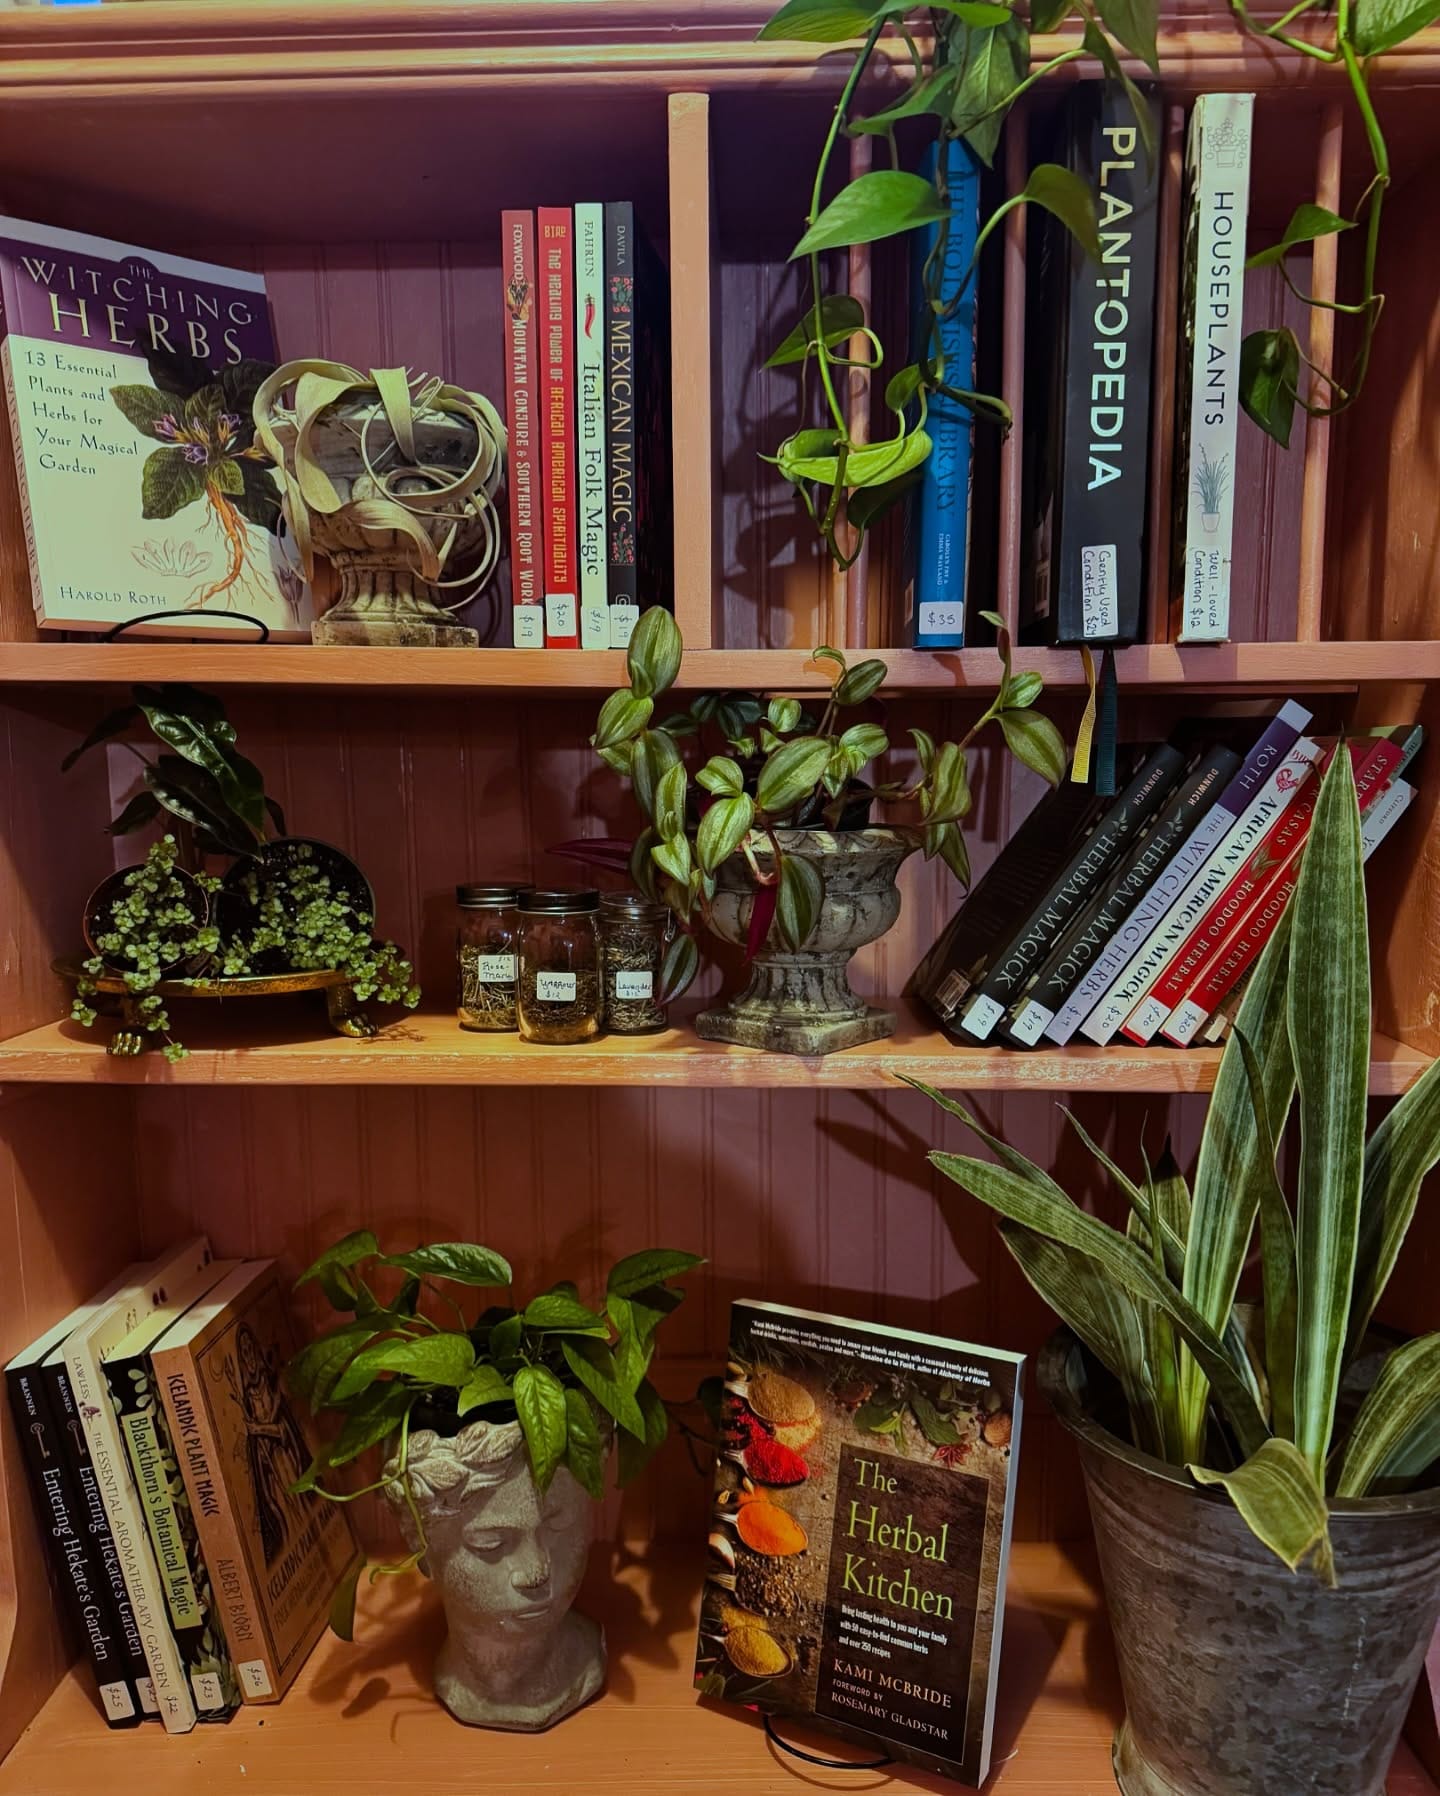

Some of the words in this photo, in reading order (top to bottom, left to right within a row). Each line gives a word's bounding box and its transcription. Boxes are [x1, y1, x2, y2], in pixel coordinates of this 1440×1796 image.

[129, 263, 151, 280] THE
[513, 224, 524, 280] FOXWOOD
[584, 221, 594, 277] FAHRUN
[617, 225, 626, 266] DAVILA
[20, 256, 252, 325] WITCHING
[1087, 127, 1137, 491] PLANTOPEDIA
[1204, 192, 1234, 425] HOUSEPLANTS
[49, 292, 242, 365] HERBS
[513, 319, 528, 384] MOUNTAIN
[25, 350, 46, 367] 13
[55, 354, 117, 379] Essential
[28, 376, 73, 397] Plants
[81, 387, 105, 401] and
[611, 320, 631, 433] MEXICAN
[33, 401, 76, 422] Herbs
[84, 409, 103, 425] for
[514, 390, 529, 446] CONJURE
[583, 363, 600, 439] Italian
[35, 427, 71, 447] Your
[80, 433, 138, 456] Magical
[39, 454, 96, 475] Garden
[516, 461, 531, 527] SOUTHERN
[585, 448, 602, 498] Folk
[612, 443, 632, 522] MAGIC
[516, 532, 532, 564] ROOT
[582, 507, 603, 575] Magic
[60, 586, 122, 602] HAROLD
[128, 591, 167, 606] ROTH
[519, 570, 534, 606] WORK
[1083, 550, 1095, 612] Condition
[1193, 551, 1206, 604] Condition
[552, 604, 569, 626] $20
[927, 611, 956, 628] $35
[1099, 597, 1111, 626] Used
[1133, 768, 1164, 806] DUNWICH
[1189, 768, 1219, 806] DUNWICH
[1240, 744, 1278, 790] ROTH
[1206, 813, 1225, 834] THE
[1224, 796, 1278, 865] AFRICAN
[1275, 801, 1312, 847] CASAS
[1054, 834, 1116, 907] HERBAL
[1108, 835, 1172, 909] HERBAL
[1124, 839, 1209, 943] WITCHING
[1161, 863, 1226, 951] AMERICAN
[1208, 879, 1254, 937] HOODOO
[1249, 880, 1295, 938] HOODOO
[995, 905, 1063, 991] MAGICK
[1047, 907, 1117, 994] MAGICK
[1079, 942, 1127, 1000] HERBS
[1114, 942, 1168, 1003] MAGICK
[1165, 939, 1210, 992] HERBAL
[1206, 941, 1250, 992] HERBAL
[19, 1376, 37, 1416] BRANNEN
[57, 1375, 74, 1413] BRANNEN
[73, 1356, 90, 1400] LAWLESS
[93, 1431, 104, 1448] THE
[184, 1438, 210, 1484] PLANT
[96, 1448, 123, 1514] ESSENTIAL
[854, 1458, 898, 1494] The
[130, 1415, 164, 1505] Blackthorn's
[152, 1506, 184, 1573] Botanical
[168, 1575, 190, 1616] Magic
[847, 1500, 948, 1563] Herbal
[43, 1467, 74, 1537] Entering
[64, 1538, 92, 1602] Hekate's
[83, 1606, 110, 1661] Garden
[79, 1467, 109, 1534] Entering
[118, 1602, 143, 1656] Garden
[114, 1519, 154, 1630] AROMATHERAPY
[216, 1559, 243, 1601] ALBERT
[842, 1553, 953, 1620] Kitchen
[146, 1634, 170, 1689] GARDEN
[833, 1658, 873, 1683] KAMI
[879, 1672, 952, 1708] MCBRIDE
[831, 1691, 888, 1719] ROSEMARY
[891, 1711, 949, 1740] GLADSTAR
[832, 1678, 871, 1698] FOREWORD
[874, 1690, 883, 1702] BY
